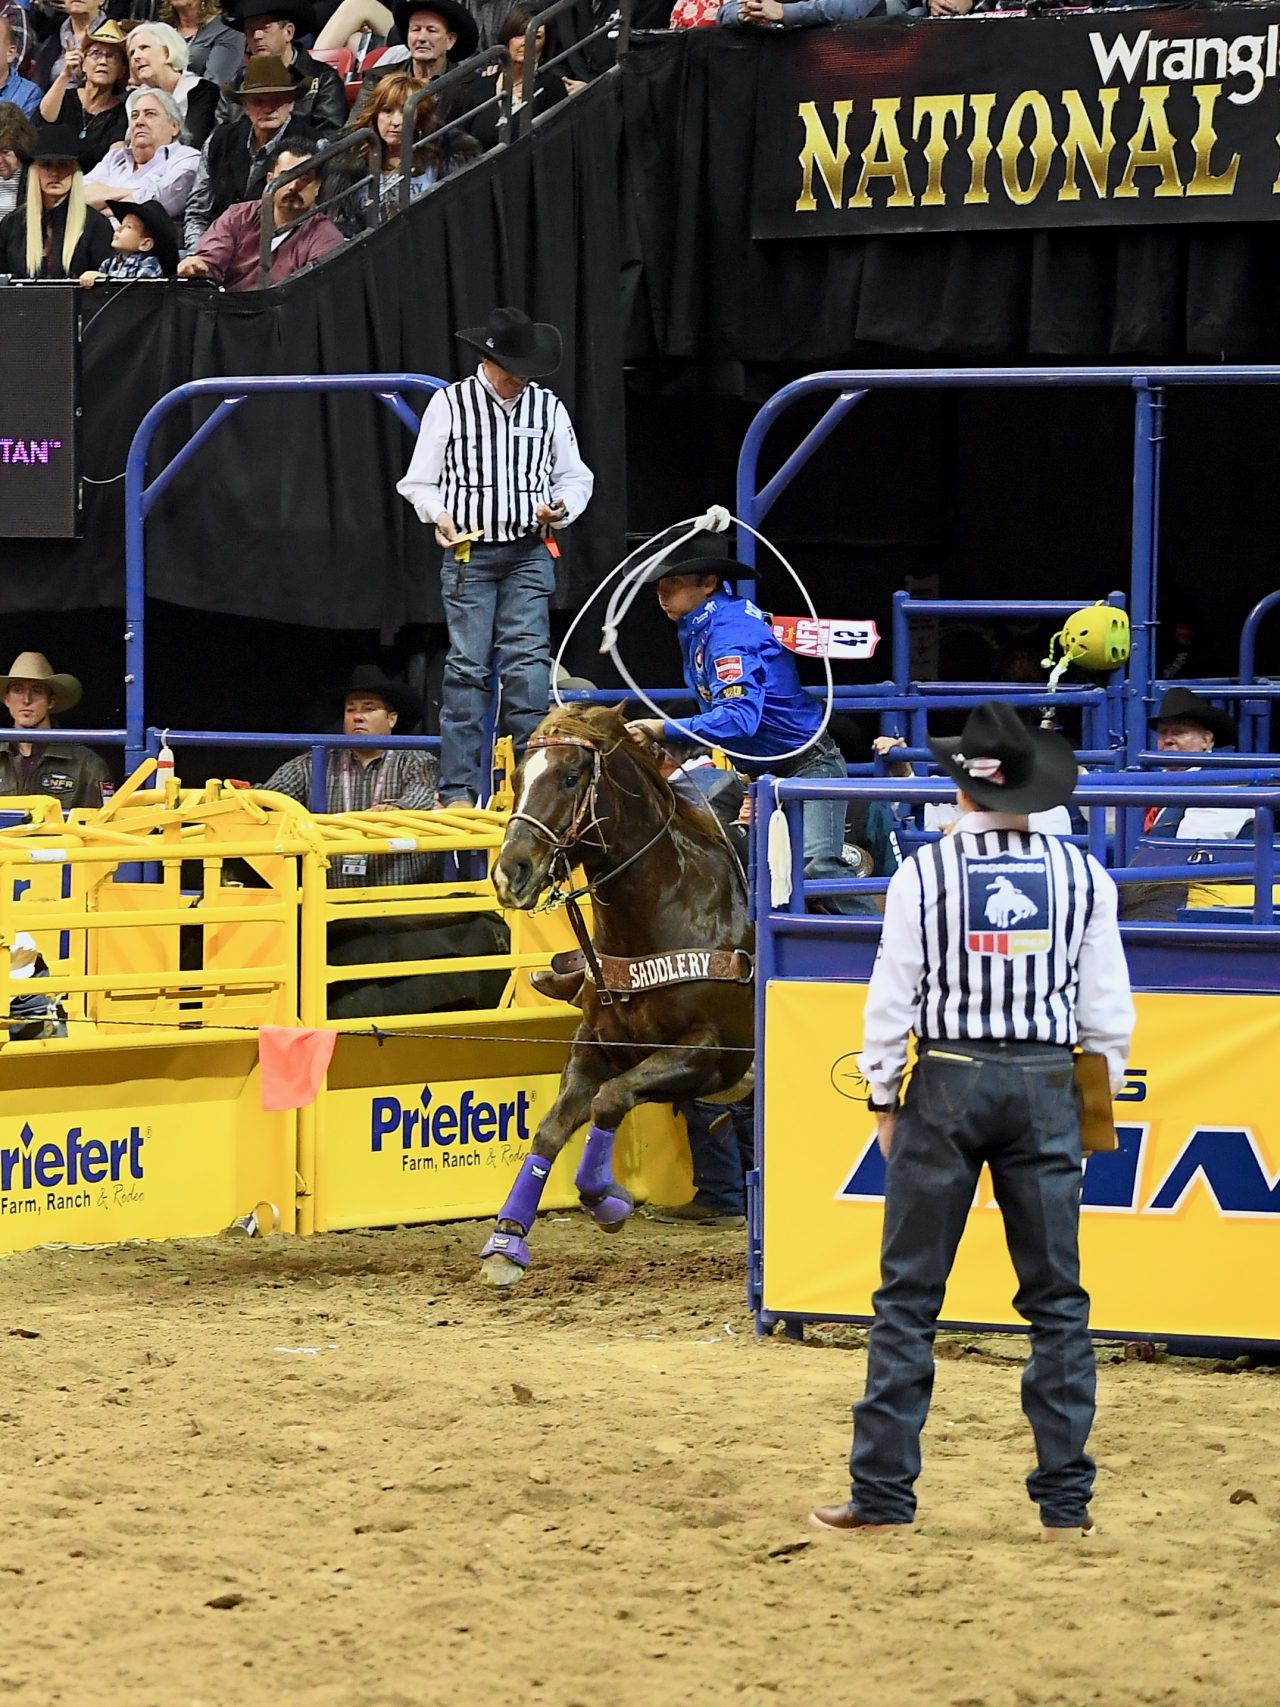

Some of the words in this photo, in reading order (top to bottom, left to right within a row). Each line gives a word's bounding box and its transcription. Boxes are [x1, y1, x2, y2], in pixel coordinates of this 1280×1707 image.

[1089, 24, 1280, 104] Wrangl
[795, 84, 1241, 212] NATIONAL
[833, 630, 869, 647] 42
[49, 779, 74, 789] NFR
[628, 952, 711, 989] SADDLERY
[372, 1084, 530, 1152] Priefert
[402, 1153, 438, 1173] Farm,
[442, 1149, 481, 1169] Ranch
[1, 1196, 42, 1216] Farm,
[46, 1191, 91, 1211] Ranch
[113, 1183, 145, 1207] Rodeo
